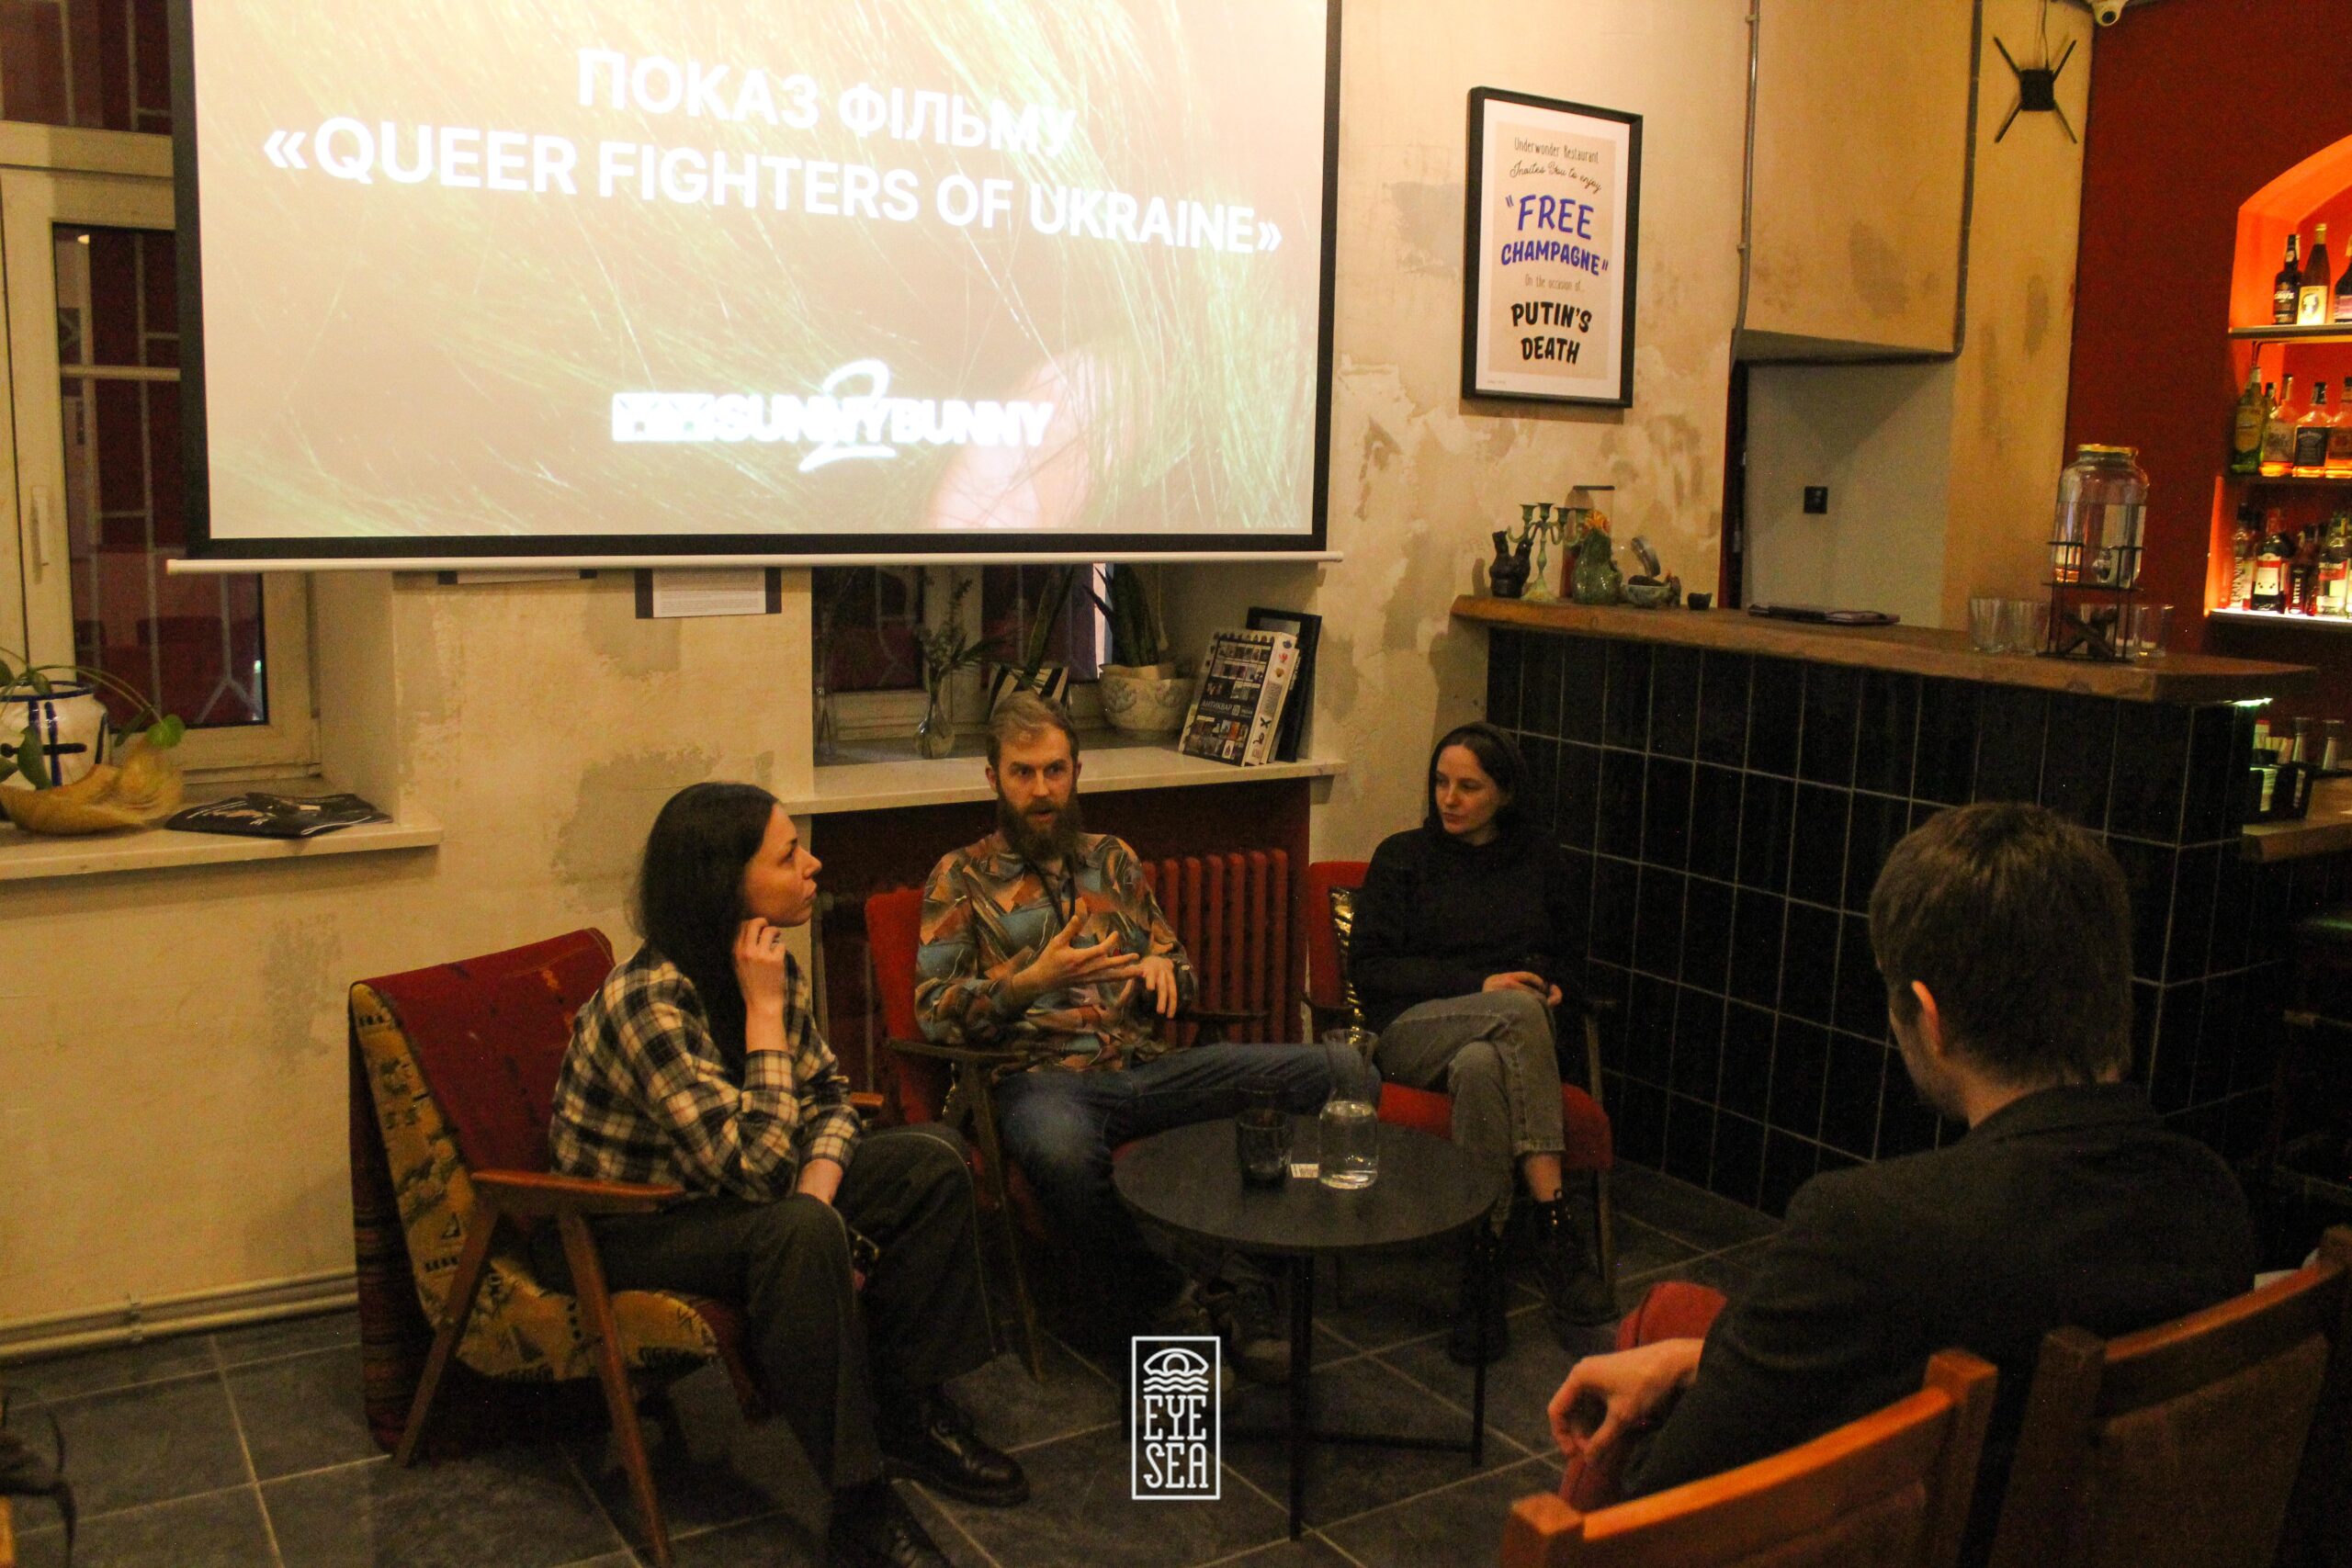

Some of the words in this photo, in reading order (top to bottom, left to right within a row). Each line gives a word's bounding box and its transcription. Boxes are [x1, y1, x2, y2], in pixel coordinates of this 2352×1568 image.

[576, 48, 820, 130] ПОКАЗ
[837, 82, 1079, 159] ФІЛЬМУ
[1514, 137, 1560, 158] Underwonder
[1564, 144, 1600, 164] Restaurant
[263, 116, 578, 196] «QUEER
[597, 141, 921, 222] FIGHTERS
[936, 175, 1014, 230] OF
[1028, 184, 1283, 254] UKRAINE»
[1547, 161, 1566, 176] You
[1567, 166, 1577, 179] to
[1579, 175, 1602, 194] enjoy
[1524, 273, 1533, 288] On
[1535, 275, 1545, 288] the
[1548, 277, 1573, 290] occasion
[1510, 300, 1593, 333] PUTIN'S
[1521, 335, 1581, 365] DEATH
[2291, 577, 2302, 604] BITTER
